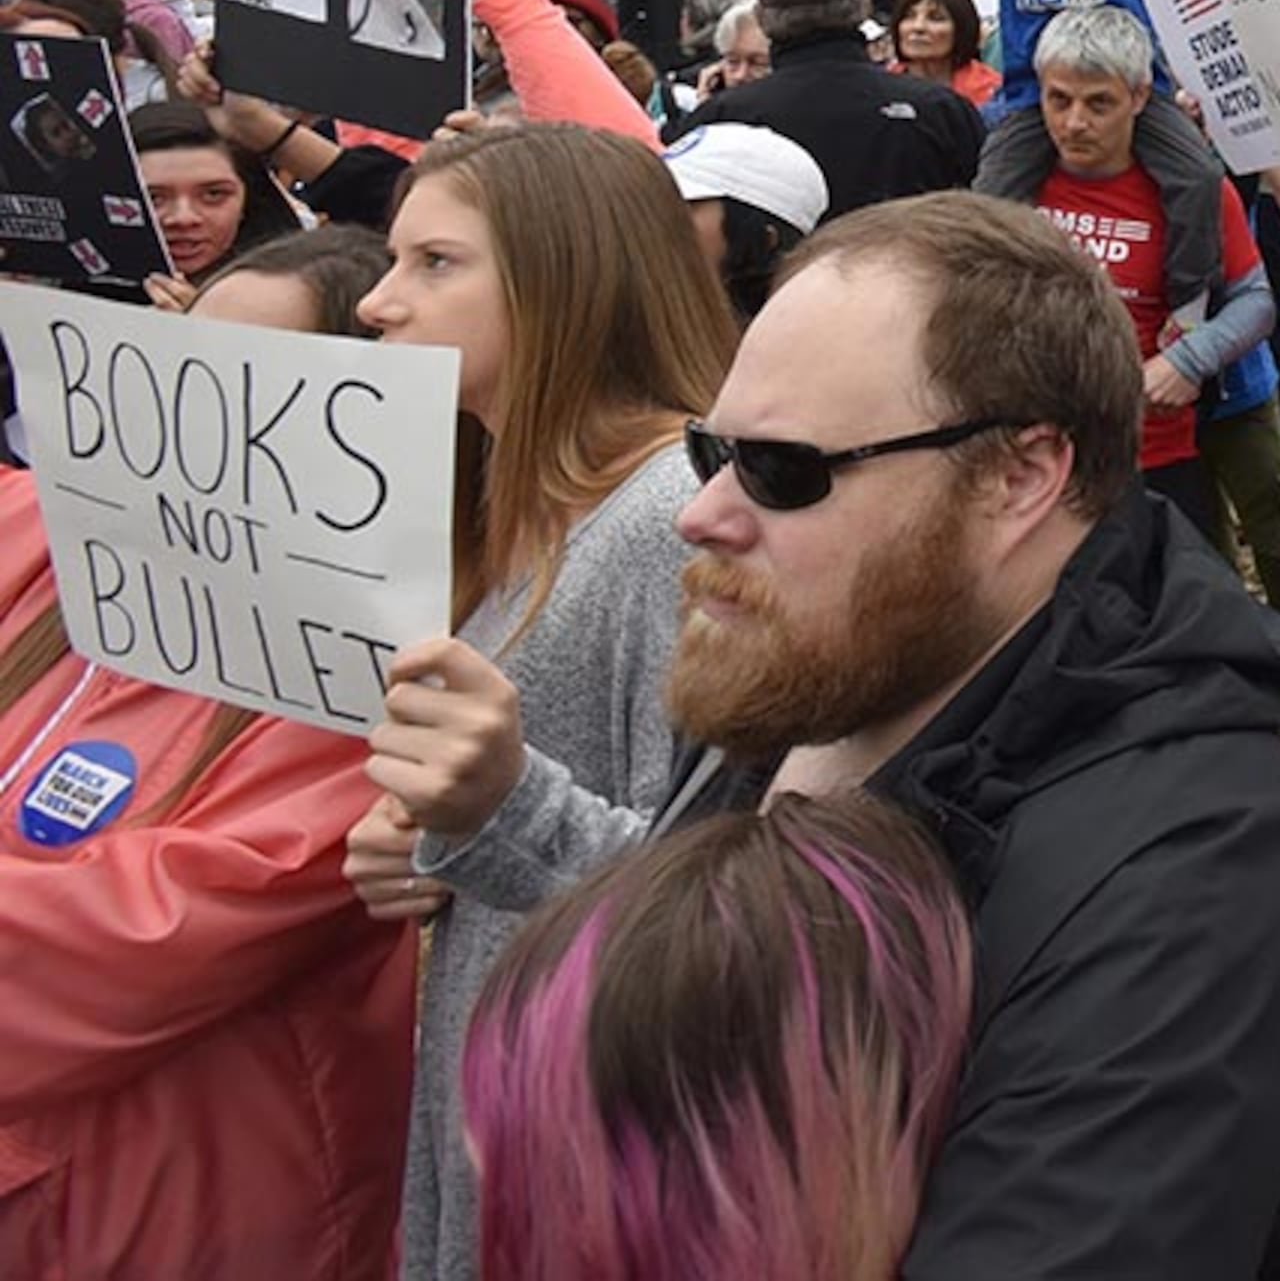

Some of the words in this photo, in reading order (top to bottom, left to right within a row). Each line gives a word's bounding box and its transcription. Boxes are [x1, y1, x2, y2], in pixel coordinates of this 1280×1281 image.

[49, 320, 388, 532] BOOKS
[157, 492, 269, 574] NOT
[85, 539, 399, 723] BULLET
